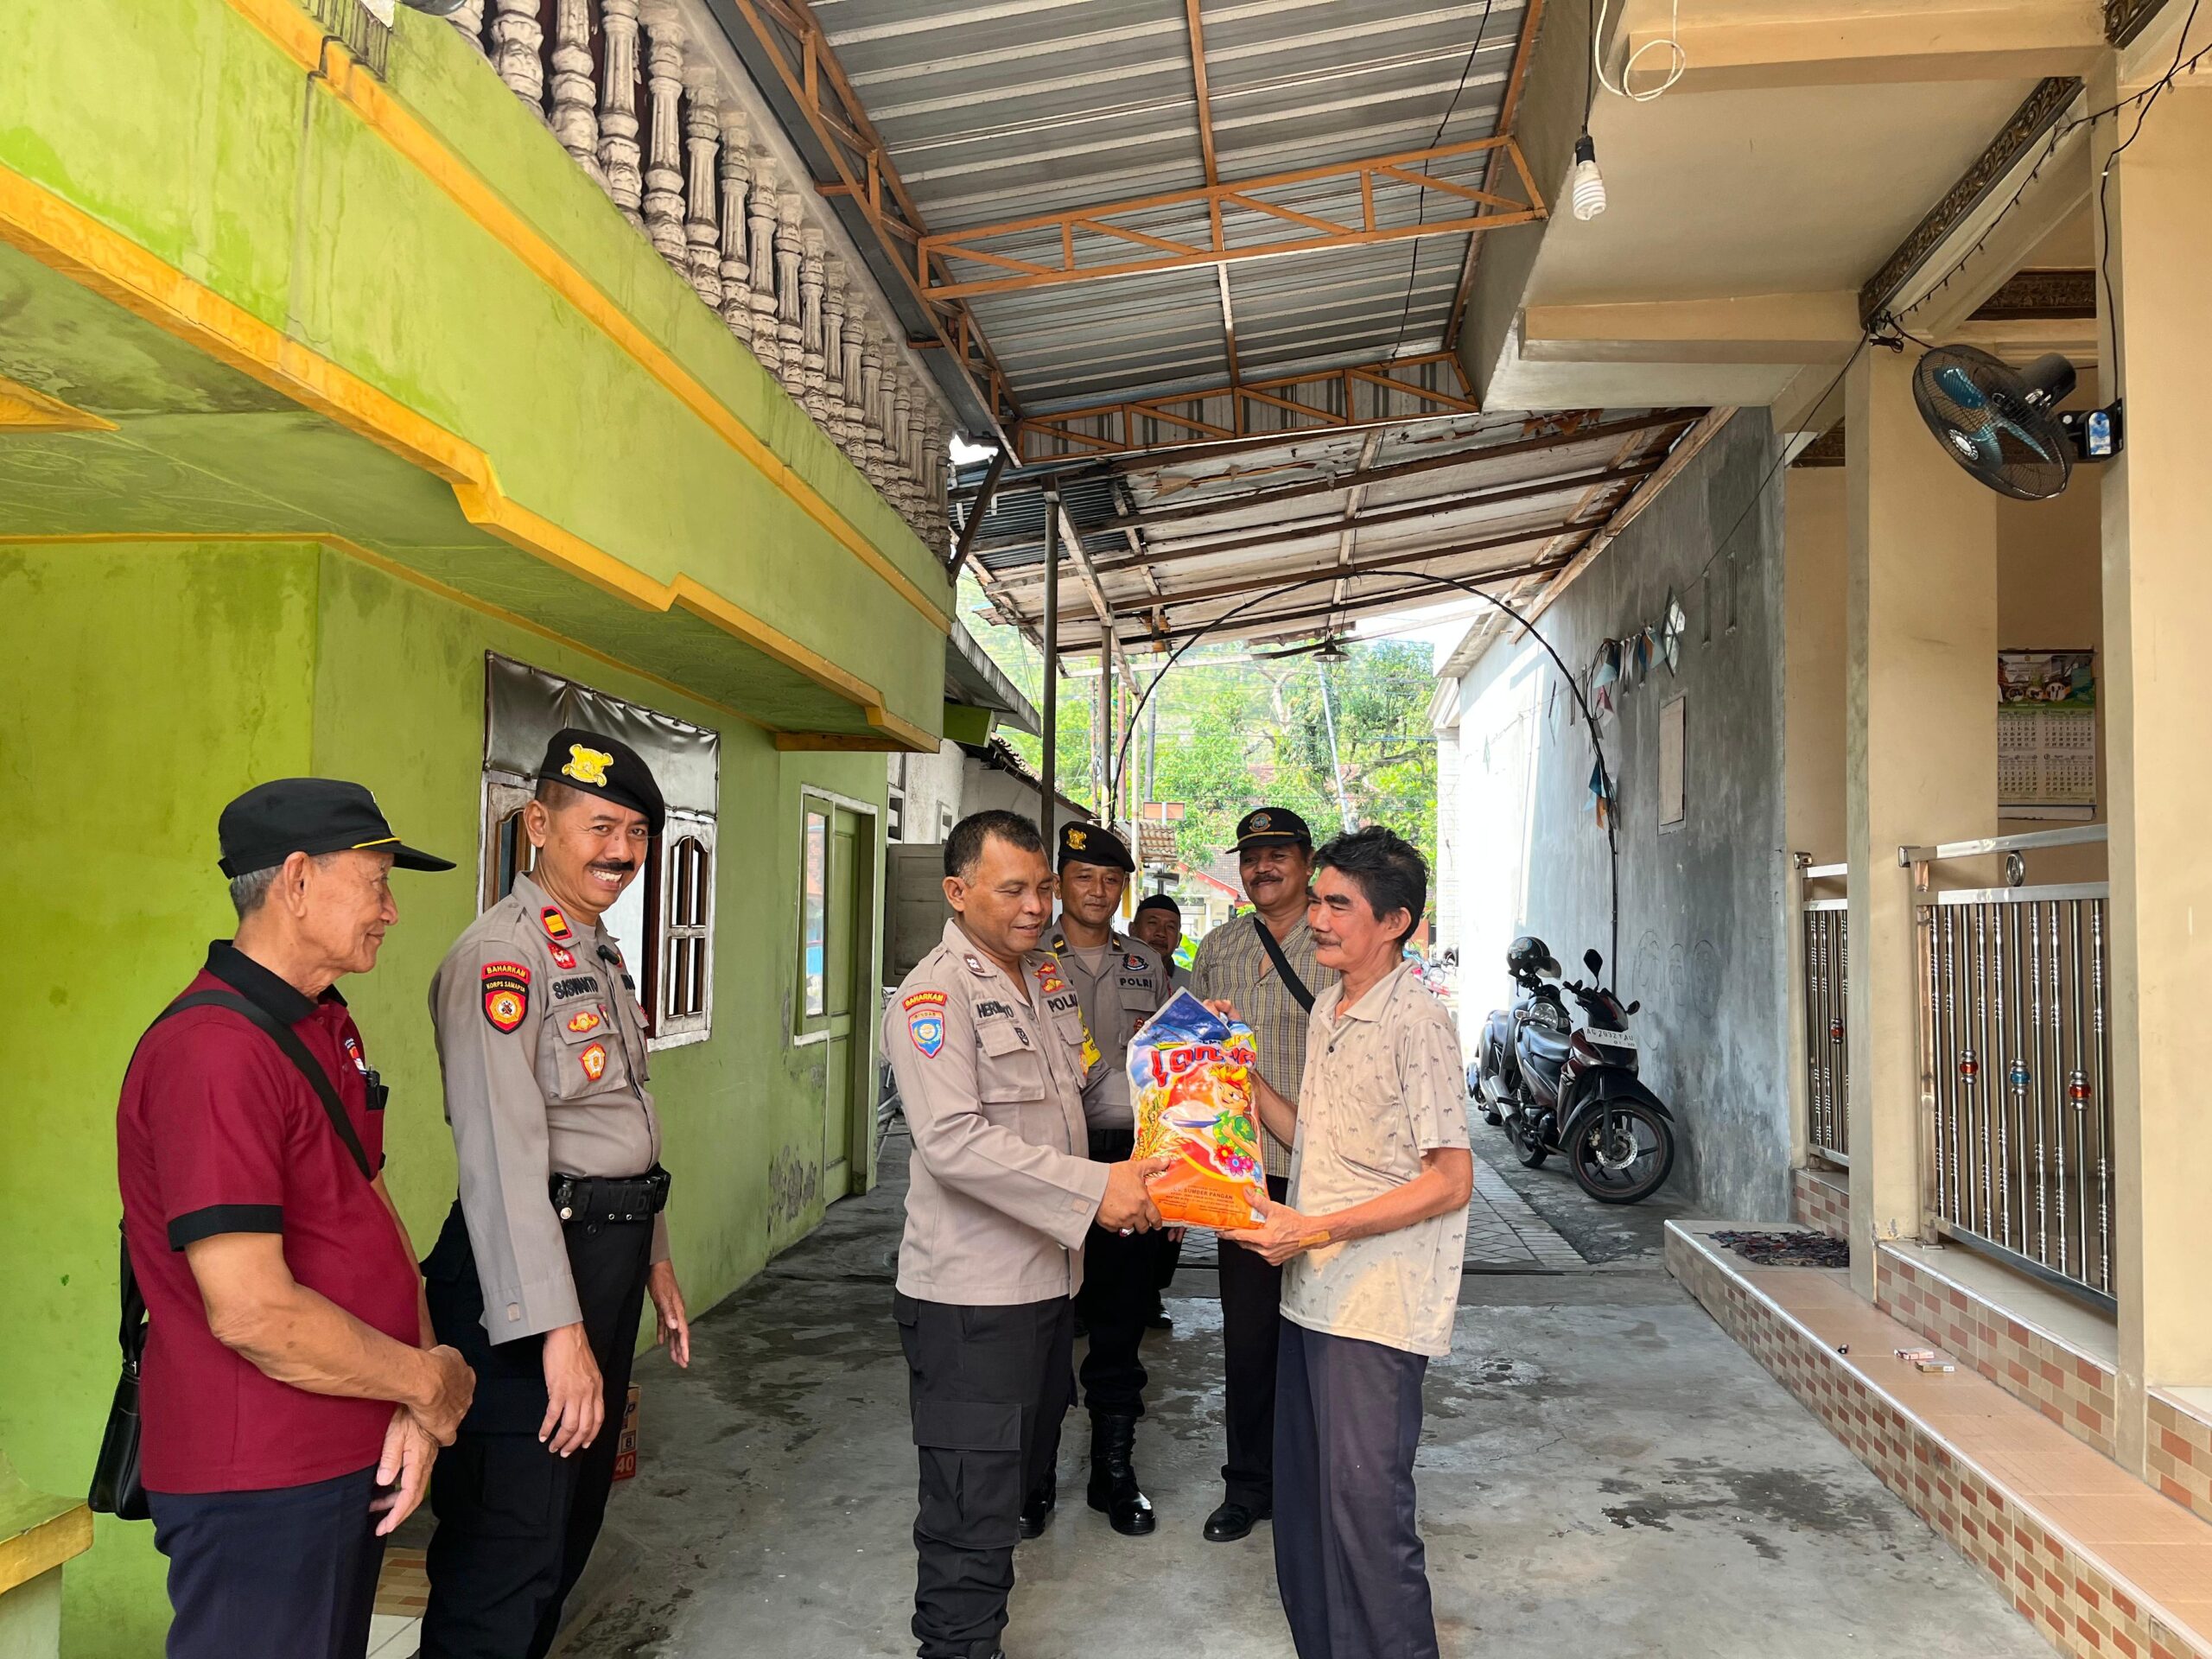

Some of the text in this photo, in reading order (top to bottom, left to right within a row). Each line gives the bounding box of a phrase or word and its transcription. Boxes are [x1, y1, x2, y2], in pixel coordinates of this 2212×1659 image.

[486, 964, 526, 977] BAHARKAM
[486, 981, 504, 990] KORPS
[1120, 977, 1154, 988] POLRI
[905, 994, 944, 1007] BAHARKAM
[615, 1454, 634, 1473] 40
